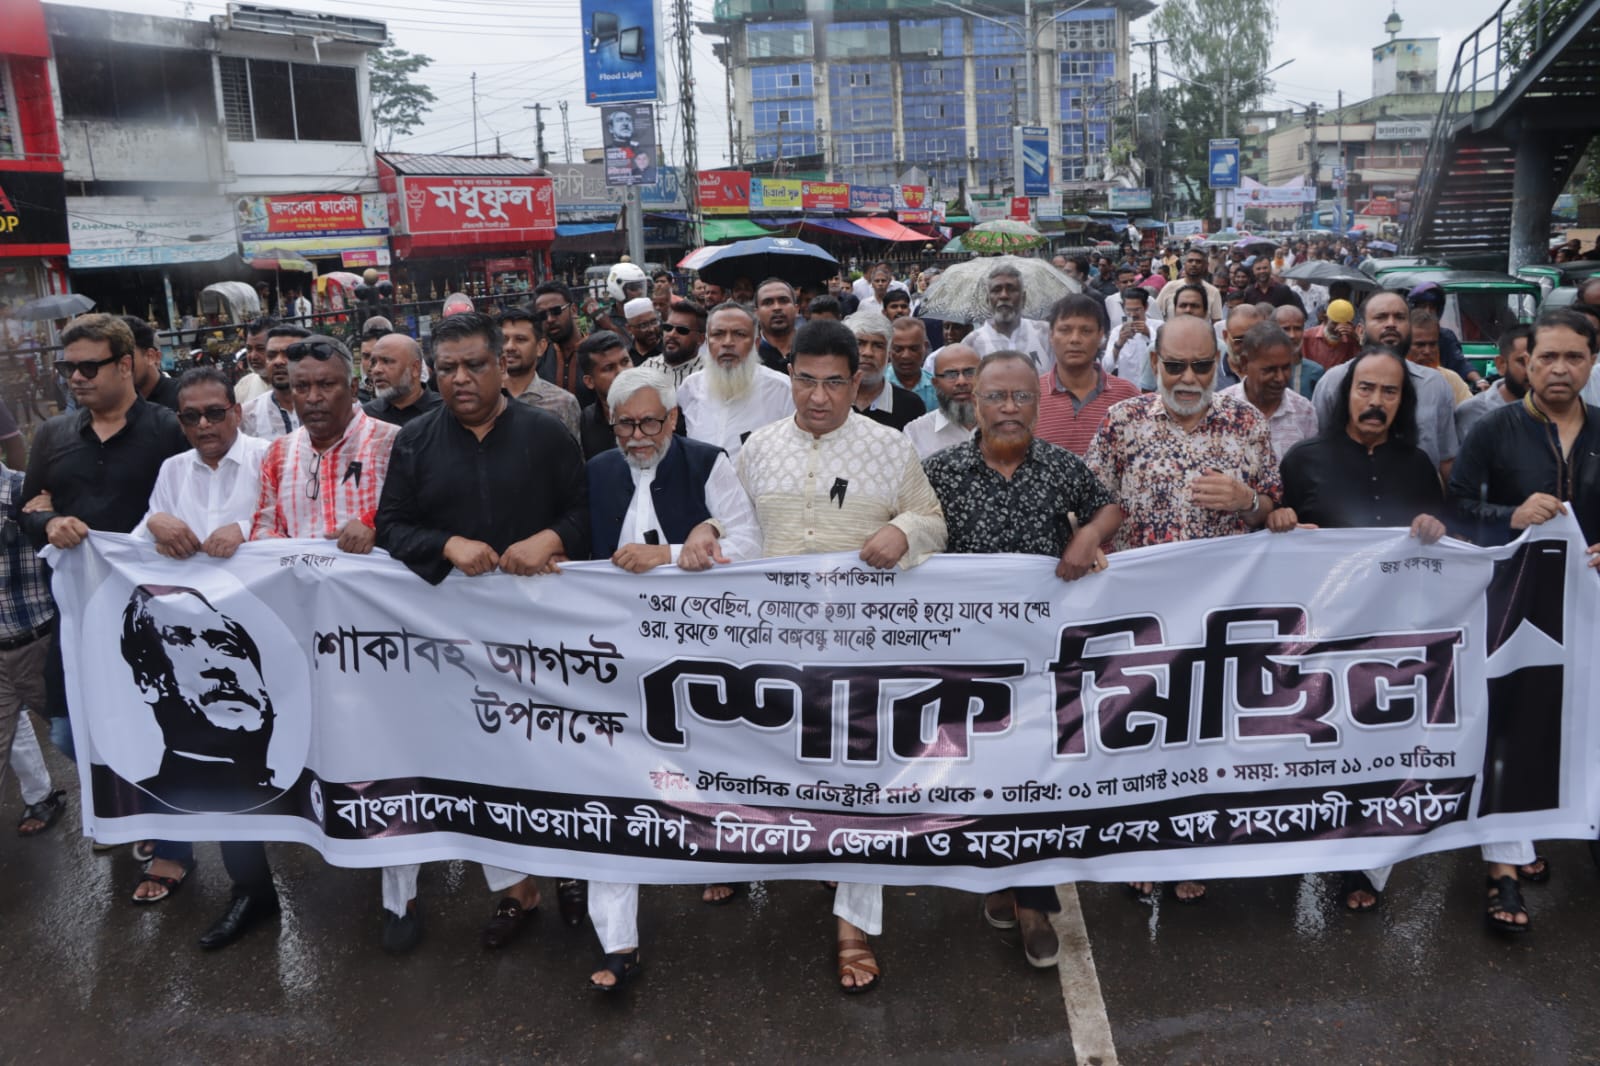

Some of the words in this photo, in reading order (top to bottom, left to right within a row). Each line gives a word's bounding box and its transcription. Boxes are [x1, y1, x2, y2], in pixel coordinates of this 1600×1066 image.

[599, 71, 621, 81] Flood
[622, 70, 643, 81] Light
[270, 199, 316, 217] জনসেবা
[318, 196, 358, 215] ফার্মেসী
[427, 185, 535, 221] মধুফুল
[280, 554, 299, 568] জয়
[302, 553, 337, 569] বাংলা
[815, 566, 897, 587] সর্বশক্তিমান
[1379, 560, 1402, 574] জয়
[681, 591, 752, 619] ভেবেছিল,
[757, 600, 823, 623] তোমাকে
[824, 601, 856, 623] হত্যা
[861, 598, 920, 624] করলেই
[924, 602, 954, 624] হয়ে
[958, 602, 993, 624] যাবে
[998, 601, 1020, 619] সব
[1024, 601, 1051, 623] শেষ
[638, 620, 669, 640] ওরা,
[674, 621, 719, 647] বুঝতে
[724, 619, 773, 648] পারেনি
[778, 628, 829, 652] বঙ্গবন্ধু
[833, 626, 877, 651] মানেই
[313, 624, 477, 681] শোকাবহ
[481, 634, 624, 686] আগস্ট
[638, 656, 1028, 765] শোক
[1048, 606, 1467, 758] মিছিল
[471, 685, 629, 746] উপলক্ষে
[649, 770, 690, 791] স্থান:
[696, 769, 791, 797] ঐতিহাসিক
[886, 782, 922, 805] মাঠ
[928, 785, 977, 803] থেকে
[1001, 780, 1062, 803] তারিখ:
[1069, 782, 1092, 799] ০১
[1097, 778, 1118, 796] লা
[1122, 769, 1168, 793] আগস্ট
[1171, 766, 1209, 787] ২০২৪
[1233, 763, 1279, 782] সময়:
[1284, 759, 1336, 778] সকাল
[1400, 744, 1457, 769] ঘটিকা
[333, 790, 478, 829] বাংলাদেশ
[485, 800, 618, 844] আওয়ামী
[624, 804, 699, 855] লীগ,
[710, 811, 817, 855] সিলেট
[828, 826, 913, 859] জেলা
[924, 833, 951, 857] ও
[963, 822, 1091, 861] মহানগর
[1098, 819, 1161, 846] এবং
[1169, 809, 1220, 842] অঙ্গ
[1226, 790, 1353, 837] সহযোগী
[1359, 782, 1467, 828] সংগঠন
